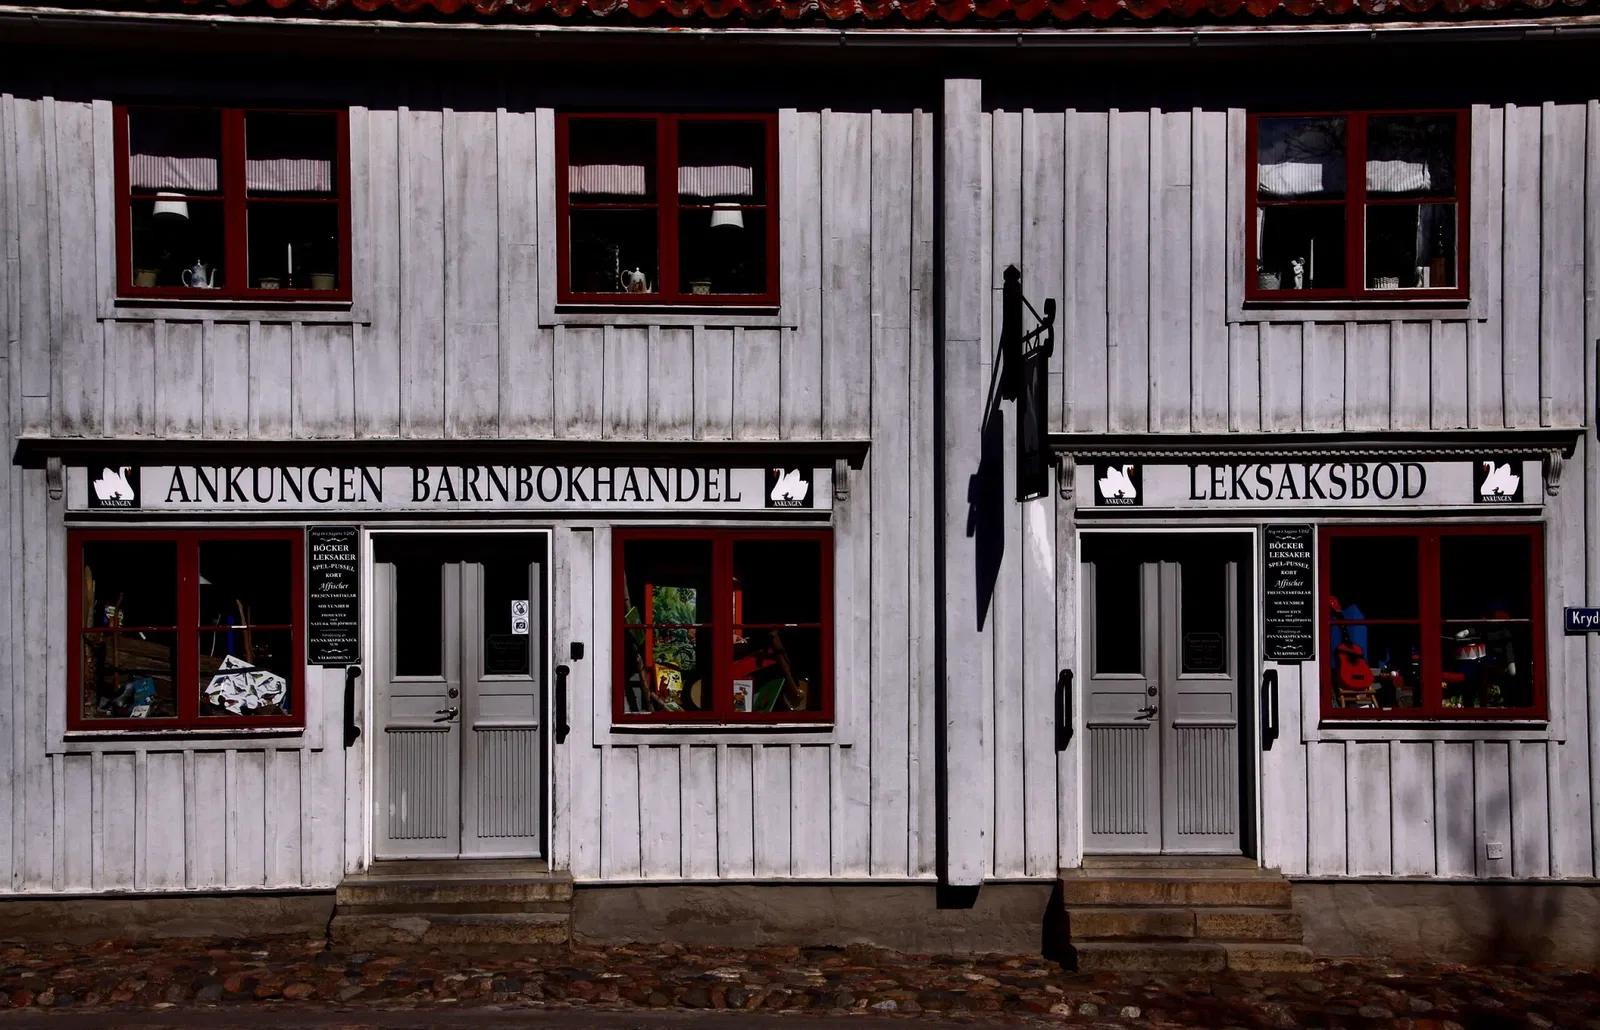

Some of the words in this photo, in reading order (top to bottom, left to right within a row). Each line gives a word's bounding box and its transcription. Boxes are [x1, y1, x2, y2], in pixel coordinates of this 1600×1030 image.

[164, 466, 383, 502] ANKUNGEN
[411, 466, 742, 502] BARNBOKHANDEL
[1188, 462, 1427, 501] LEKSAKSBOD
[313, 544, 349, 552] BÖCKER
[1269, 541, 1304, 549] BÖCKER
[319, 582, 349, 591] Affischer
[1274, 579, 1304, 588] Affischer
[1572, 611, 1600, 628] Kryd
